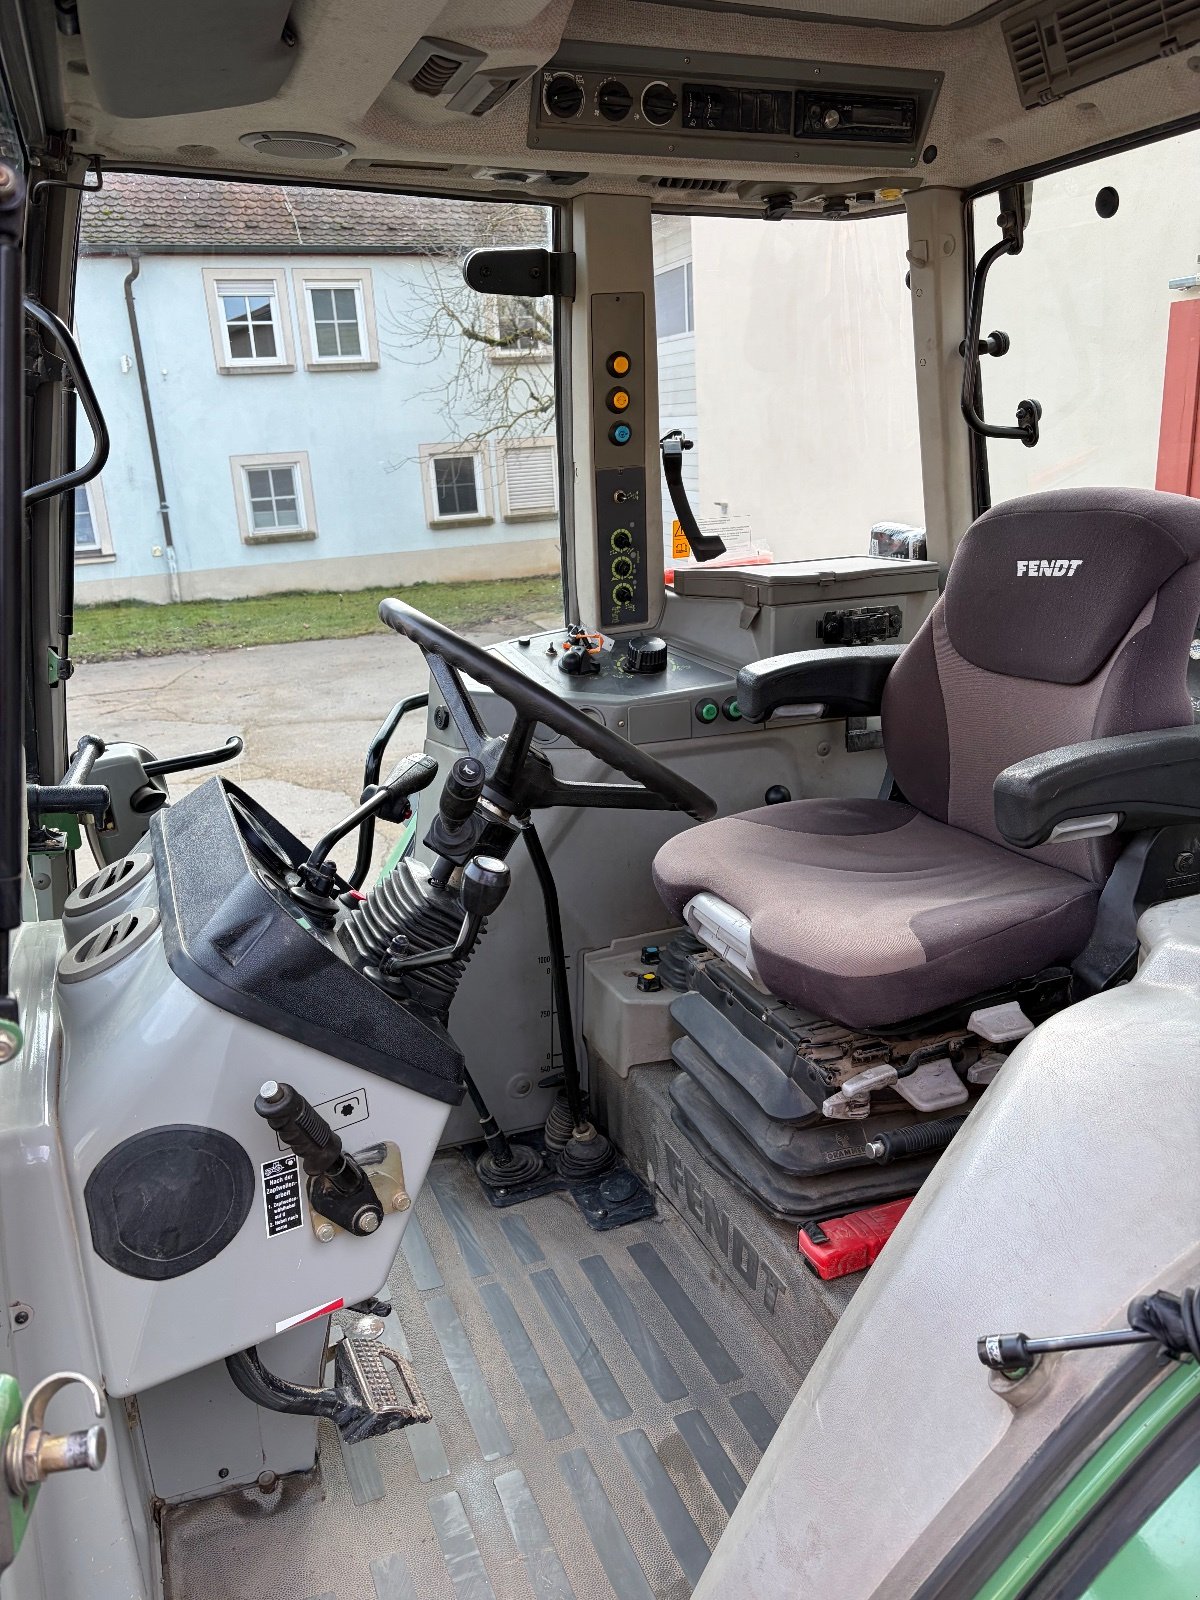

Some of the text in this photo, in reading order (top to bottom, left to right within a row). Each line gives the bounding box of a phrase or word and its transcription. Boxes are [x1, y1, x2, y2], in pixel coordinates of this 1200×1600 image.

[1016, 559, 1083, 577] FENDT
[537, 955, 551, 964] 1000
[546, 967, 551, 975] 0
[540, 1065, 551, 1073] 540
[664, 1139, 788, 1316] FENDT
